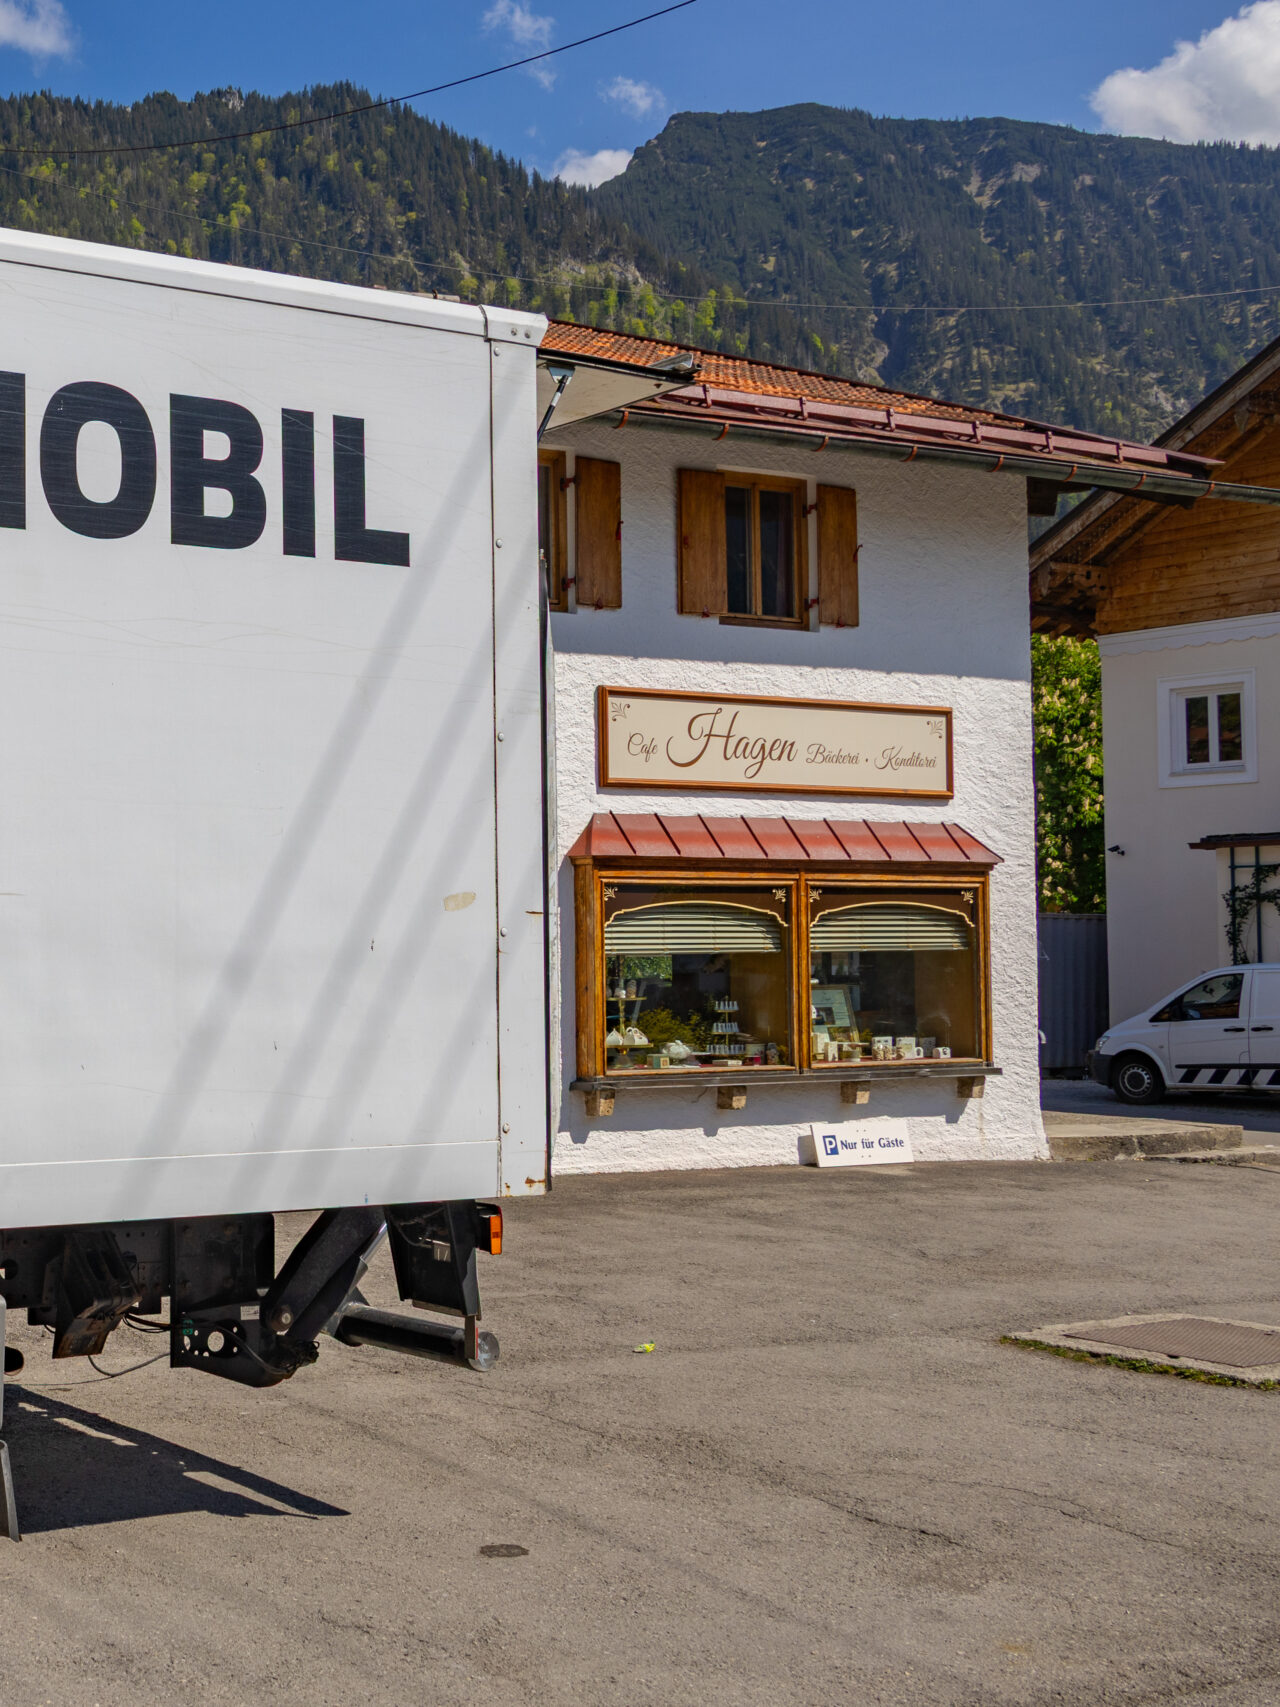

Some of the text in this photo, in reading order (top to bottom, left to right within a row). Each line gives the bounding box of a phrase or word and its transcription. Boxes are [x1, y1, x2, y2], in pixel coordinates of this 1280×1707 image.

[627, 707, 937, 779] Cafe Hagen Bäckerei Konditorei
[824, 1137, 904, 1154] P Nur für Gäste
